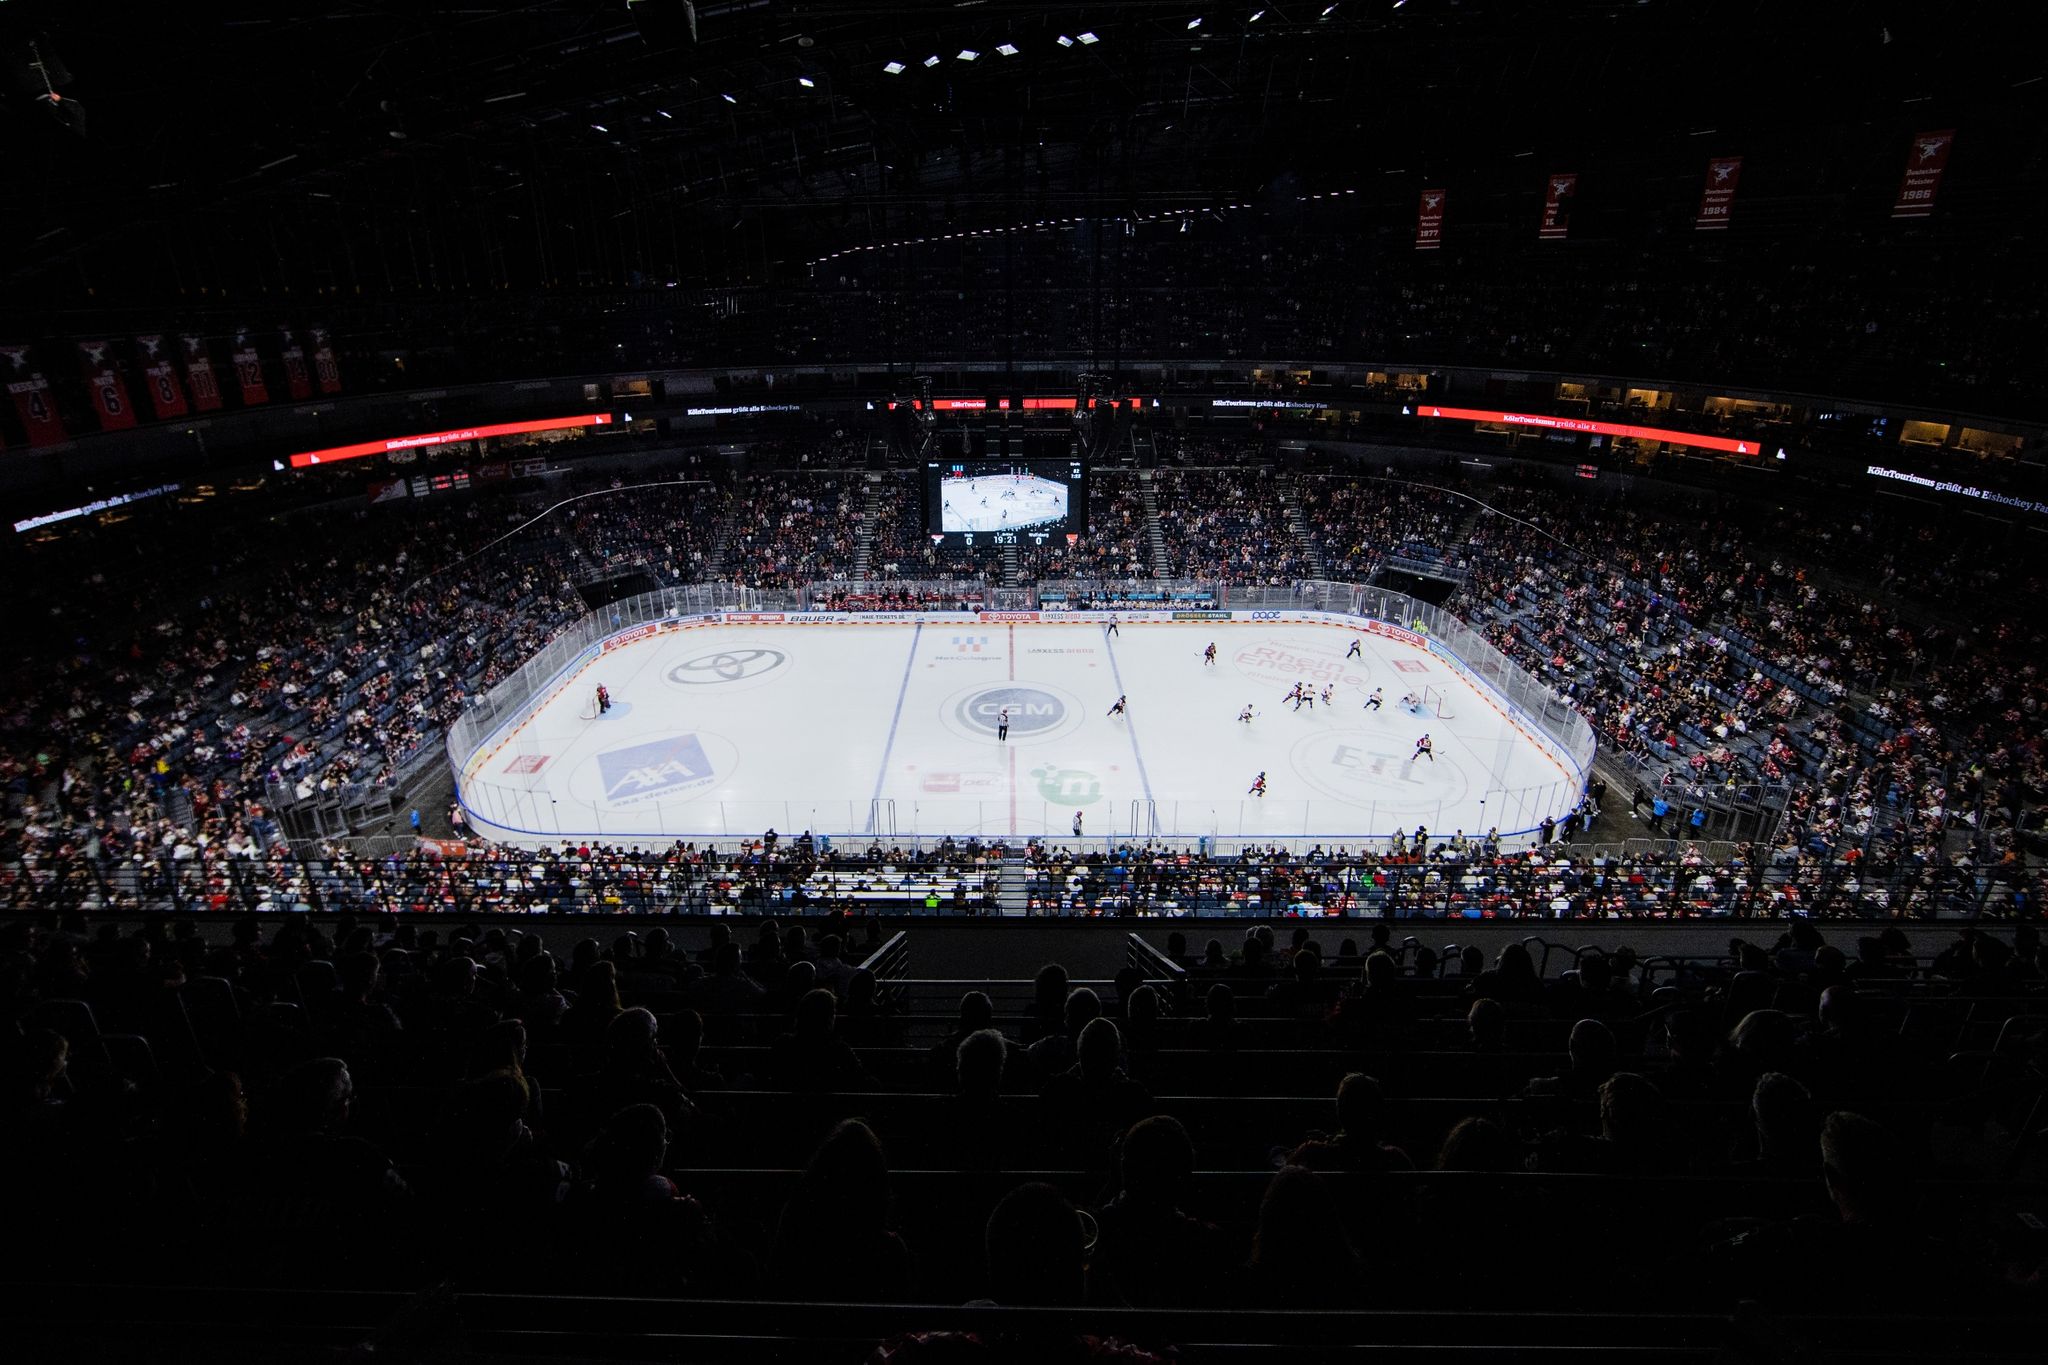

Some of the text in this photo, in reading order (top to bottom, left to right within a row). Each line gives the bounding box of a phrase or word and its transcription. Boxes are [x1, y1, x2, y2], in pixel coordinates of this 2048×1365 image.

[1906, 168, 1941, 176] Deutscher
[1902, 189, 1931, 200] 1986
[1703, 206, 1727, 215] 1984
[1420, 229, 1438, 237] 1977
[236, 363, 263, 388] 12
[158, 377, 175, 404] 8
[29, 391, 50, 423] 4
[102, 386, 122, 416] 6
[687, 407, 732, 415] KölnTourismus
[733, 406, 749, 414] grüßt
[1503, 415, 1556, 427] KölnTourismus
[1556, 421, 1576, 430] grüßt
[1577, 422, 1591, 431] alle
[1867, 465, 1935, 488] KölnTourismus
[1935, 480, 1962, 493] grüßt
[1962, 486, 1981, 498] alle
[1983, 490, 2034, 511] Eishockey
[966, 537, 973, 545] 0
[993, 536, 1017, 544] 19:21
[1035, 537, 1042, 545] 0
[1000, 592, 1034, 600] STETSO
[1251, 611, 1281, 620] pape
[620, 628, 649, 643] TOYOTA
[1390, 627, 1419, 643] TOYOTA
[1254, 647, 1345, 673] Rhein
[1235, 652, 1364, 685] Energie
[976, 703, 1054, 716] CGM
[1331, 744, 1424, 785] ETL
[607, 760, 696, 796] AXA
